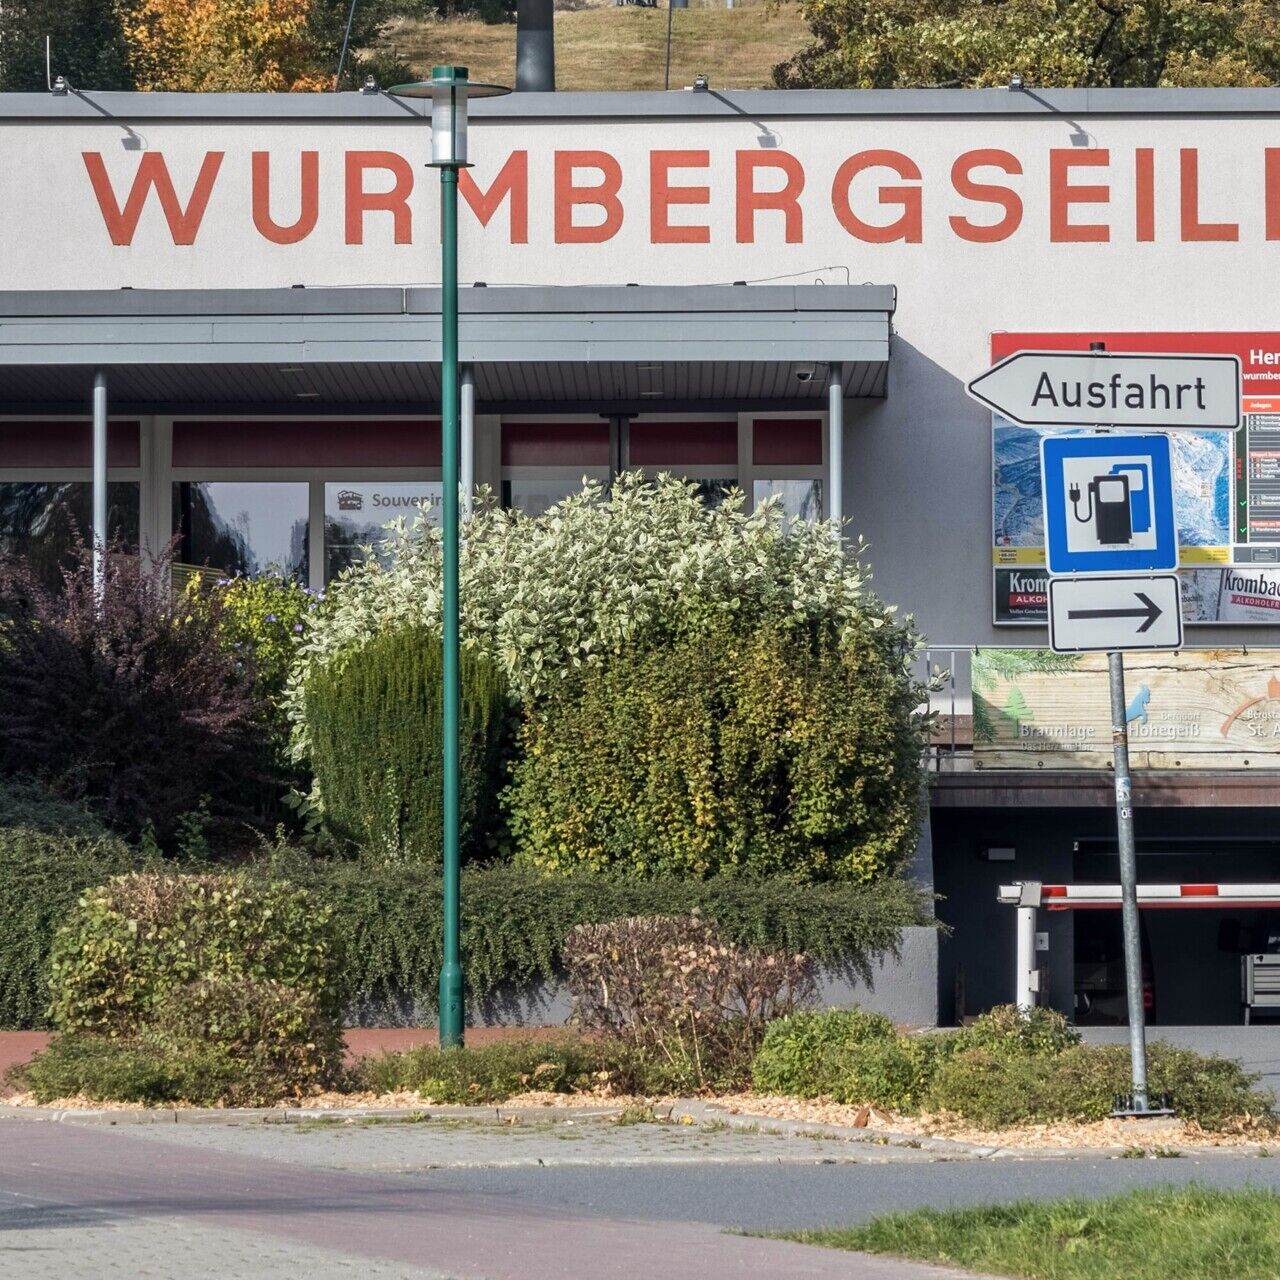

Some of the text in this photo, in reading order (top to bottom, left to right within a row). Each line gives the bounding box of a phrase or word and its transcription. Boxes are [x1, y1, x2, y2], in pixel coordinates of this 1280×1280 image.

[1030, 371, 1206, 410] Ausfahrt
[1021, 724, 1095, 739] Braunlage
[1129, 723, 1201, 739] Hohegeiß
[1247, 723, 1268, 737] St.
